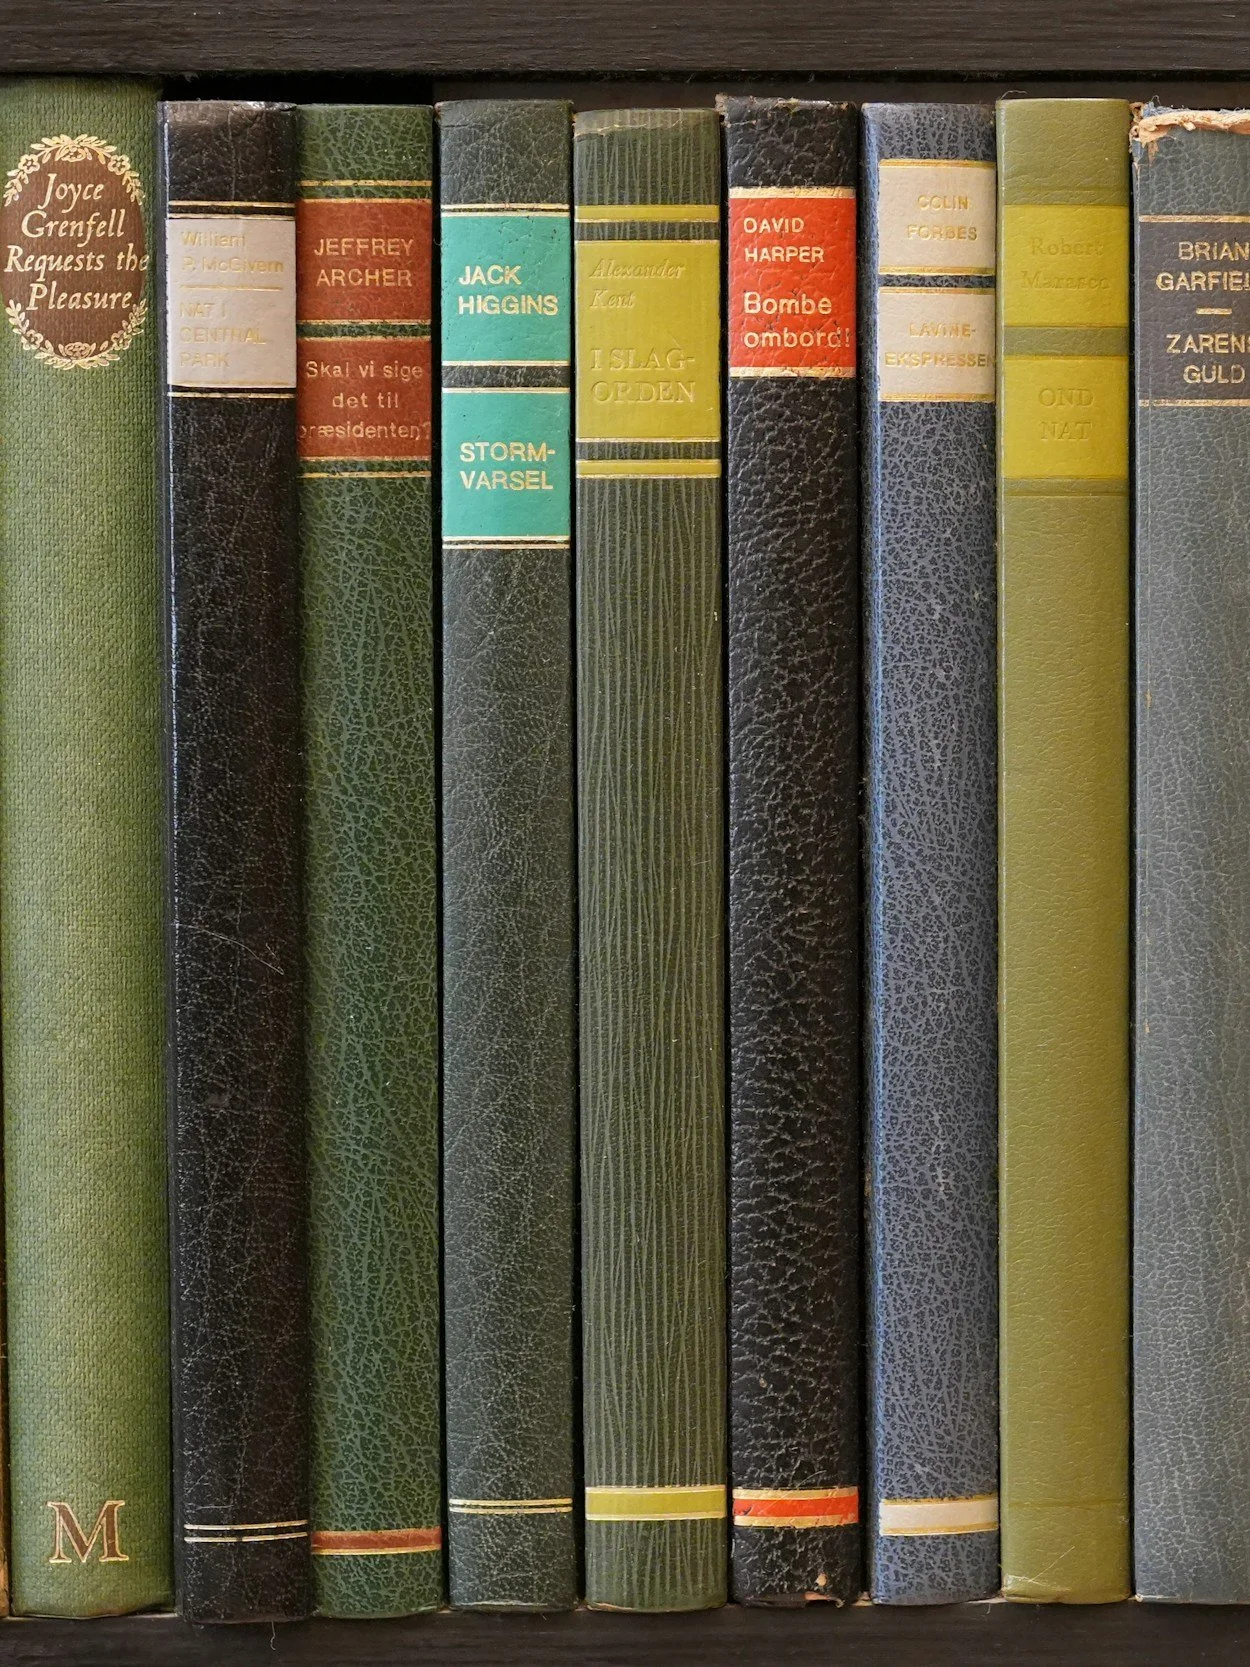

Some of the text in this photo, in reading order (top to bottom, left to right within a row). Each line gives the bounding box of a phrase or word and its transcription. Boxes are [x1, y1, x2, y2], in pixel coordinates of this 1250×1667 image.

[37, 173, 104, 213] Joyce
[917, 194, 969, 210] COLIN
[21, 208, 126, 248] Grenfell
[743, 217, 804, 233] DAVID
[906, 223, 978, 241] FORBES
[181, 231, 245, 248] William
[314, 238, 413, 256] JEFFREY
[1030, 236, 1104, 257] Robert
[744, 245, 825, 263] HARPER
[1178, 241, 1250, 261] BRIAN
[3, 243, 149, 282] Requests the
[202, 256, 284, 273] McGivern
[589, 258, 687, 280] Alexander
[316, 269, 412, 287] ARCHER
[458, 265, 522, 286] JACK
[26, 281, 132, 311] Pleasure
[458, 294, 559, 316] HIGGINS
[589, 288, 636, 308] Kent
[743, 291, 832, 315] Bombe
[180, 302, 214, 319] NAT
[180, 326, 267, 345] CENTRAL
[743, 327, 850, 348] ombord!
[907, 321, 976, 338] LAVINE-
[180, 352, 230, 368] PARK
[591, 347, 695, 371] I SLAG-
[306, 360, 424, 382] Skal vi sige
[1183, 364, 1246, 384] GULD
[332, 391, 399, 409] det til
[591, 380, 696, 403] ORDEN
[1038, 388, 1094, 407] OND
[1040, 421, 1093, 440] NAT
[459, 442, 555, 463] STORM-
[459, 470, 553, 491] VARSEL
[47, 1500, 129, 1563] M
